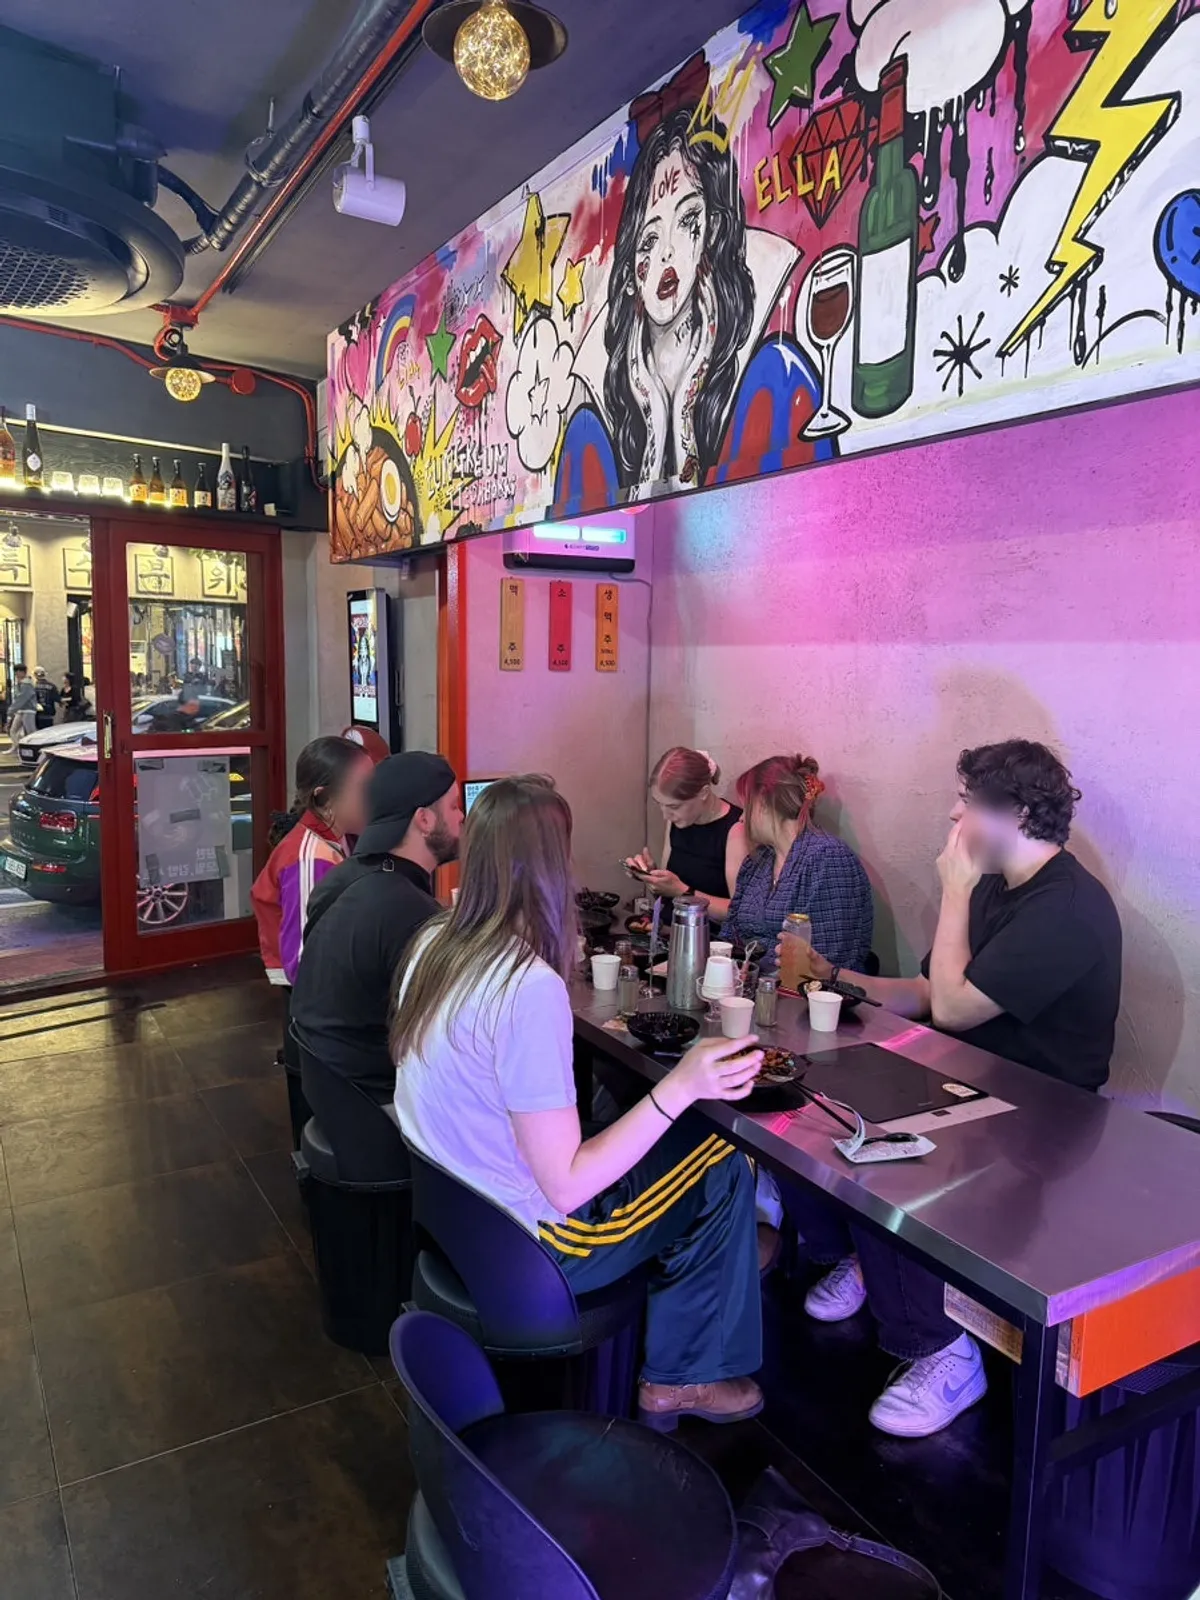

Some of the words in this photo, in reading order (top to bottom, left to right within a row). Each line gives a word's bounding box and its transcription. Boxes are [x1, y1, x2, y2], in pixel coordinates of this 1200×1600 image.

[651, 165, 681, 207] LOVE
[753, 146, 842, 213] ELLA
[603, 589, 613, 644] 생맥주
